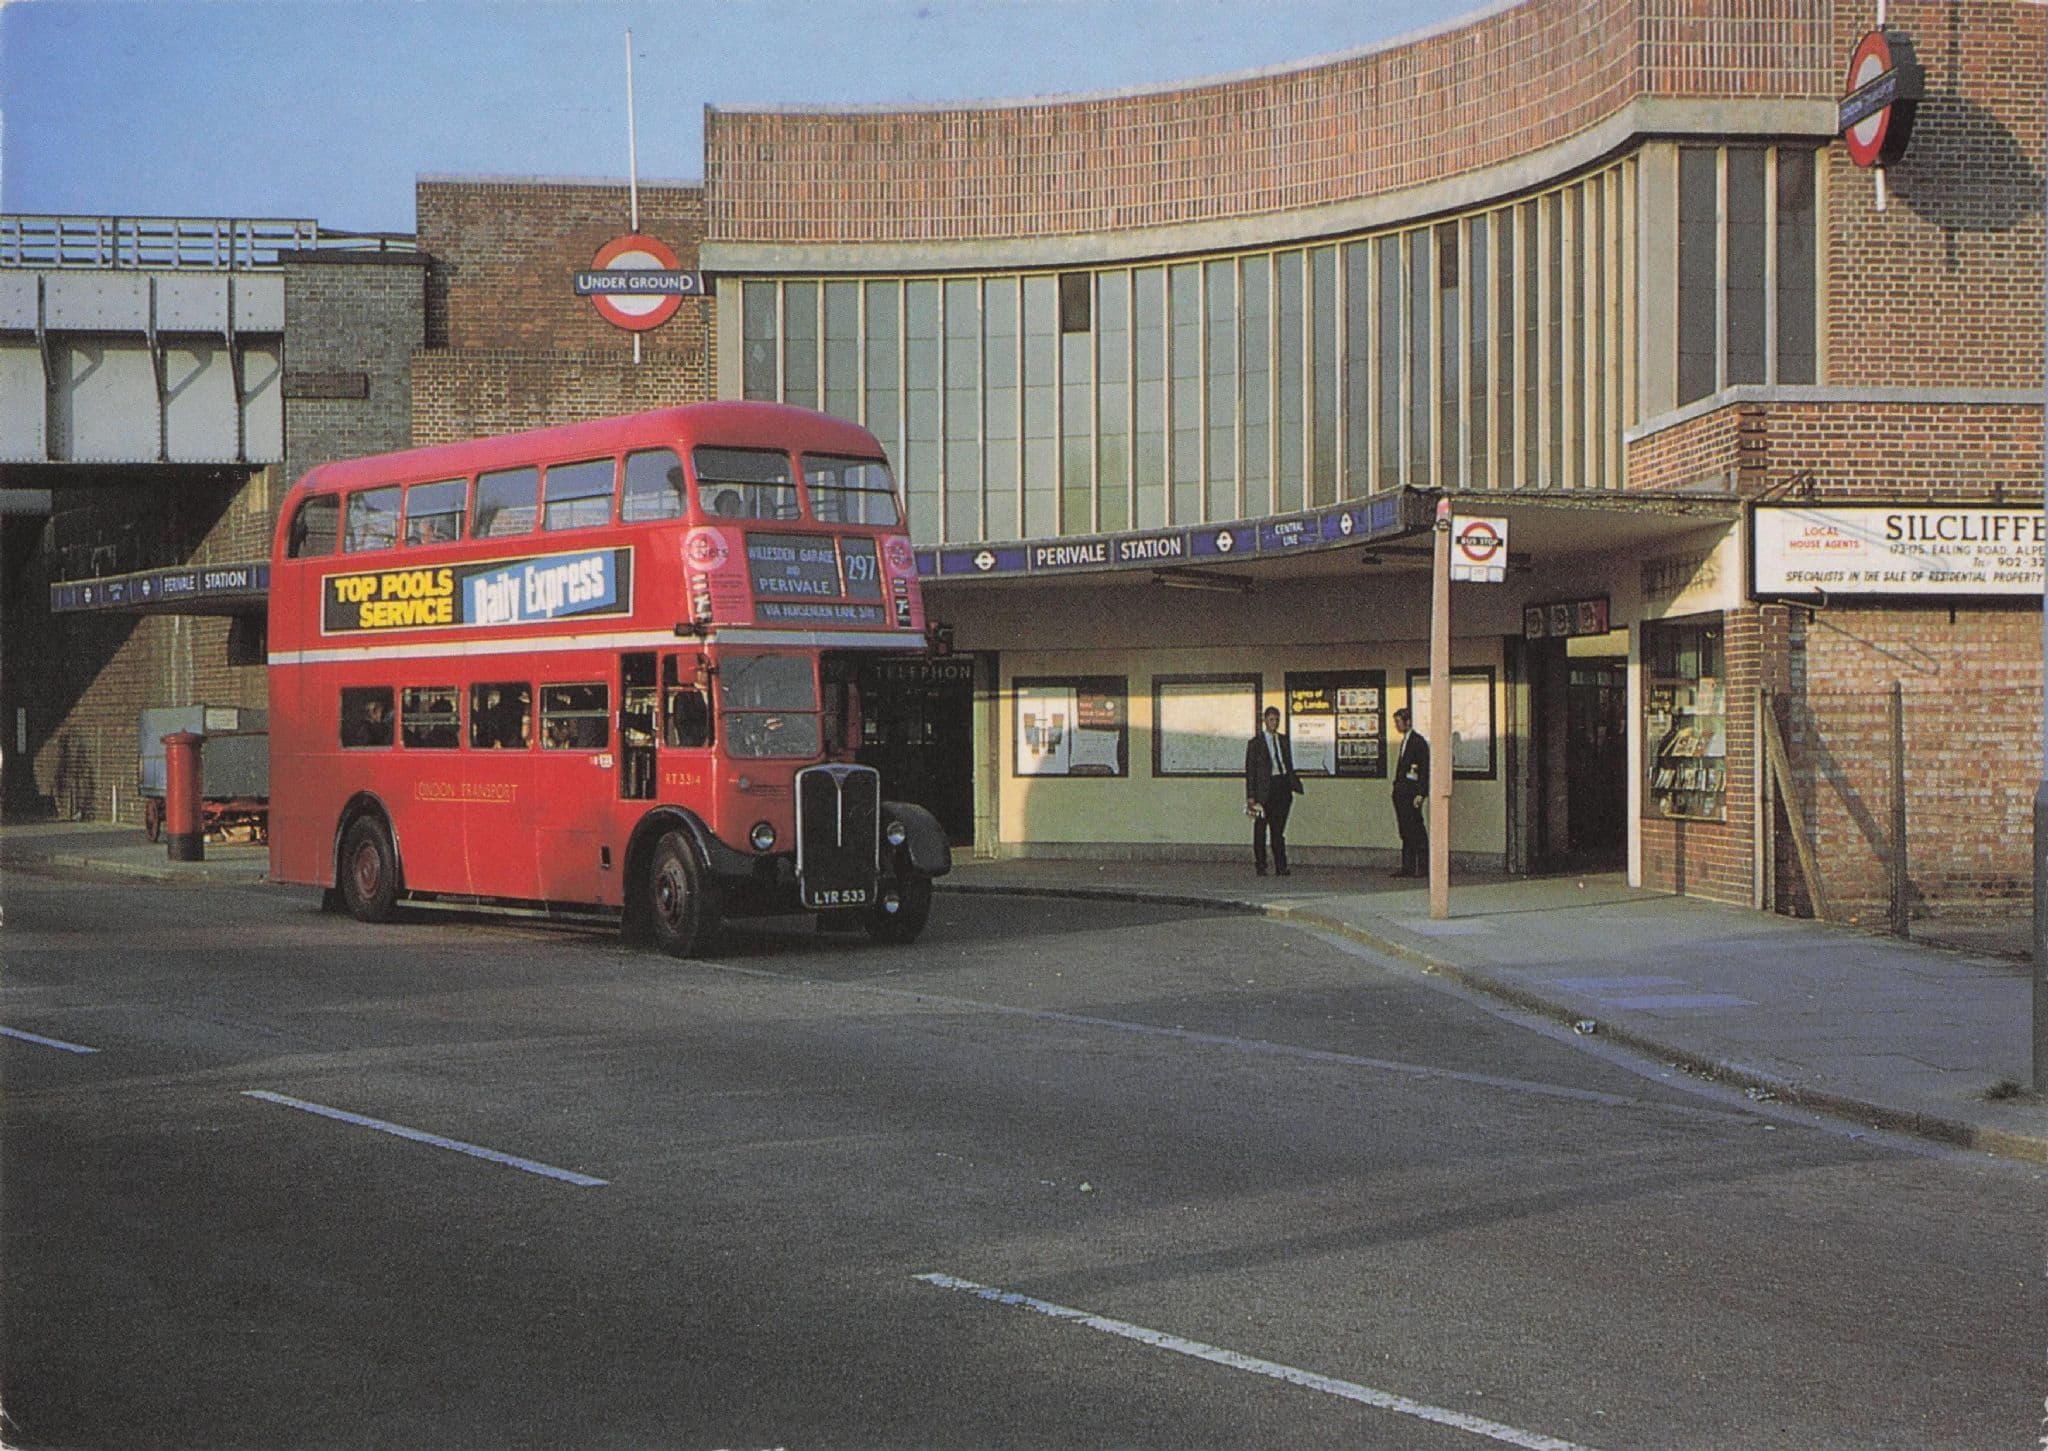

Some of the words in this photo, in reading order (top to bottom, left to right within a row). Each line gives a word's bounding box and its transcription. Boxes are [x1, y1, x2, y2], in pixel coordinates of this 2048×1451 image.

[1275, 521, 1304, 535] CENTRAL
[1804, 526, 1839, 537] LOCAL
[1461, 535, 1477, 546] BUS
[1480, 536, 1499, 546] STOP
[1789, 540, 1820, 549] HOUSE
[1825, 539, 1859, 549] AGENTS
[800, 549, 834, 563] GARAGE
[1036, 544, 1106, 567] PERIVALE
[1121, 537, 1182, 560] STATION
[1932, 544, 1971, 555] EALING
[845, 554, 876, 581] 297
[204, 570, 247, 589] STATION
[1785, 570, 1843, 582] SPECIALISTS
[1849, 570, 1858, 581] IN
[1863, 571, 1880, 581] THE
[1883, 571, 1905, 582] SALE
[1993, 571, 2042, 583] PROPERTY
[335, 576, 377, 602] TOP
[381, 568, 453, 600] POOLS
[474, 572, 520, 624] Daily
[525, 556, 604, 617] Express
[759, 578, 831, 594] PERIVALE
[360, 597, 453, 627] SERVICE
[414, 782, 455, 800] LONDON
[461, 783, 519, 803] TRANSPORT
[814, 891, 839, 904] LYR
[842, 889, 866, 902] 533
